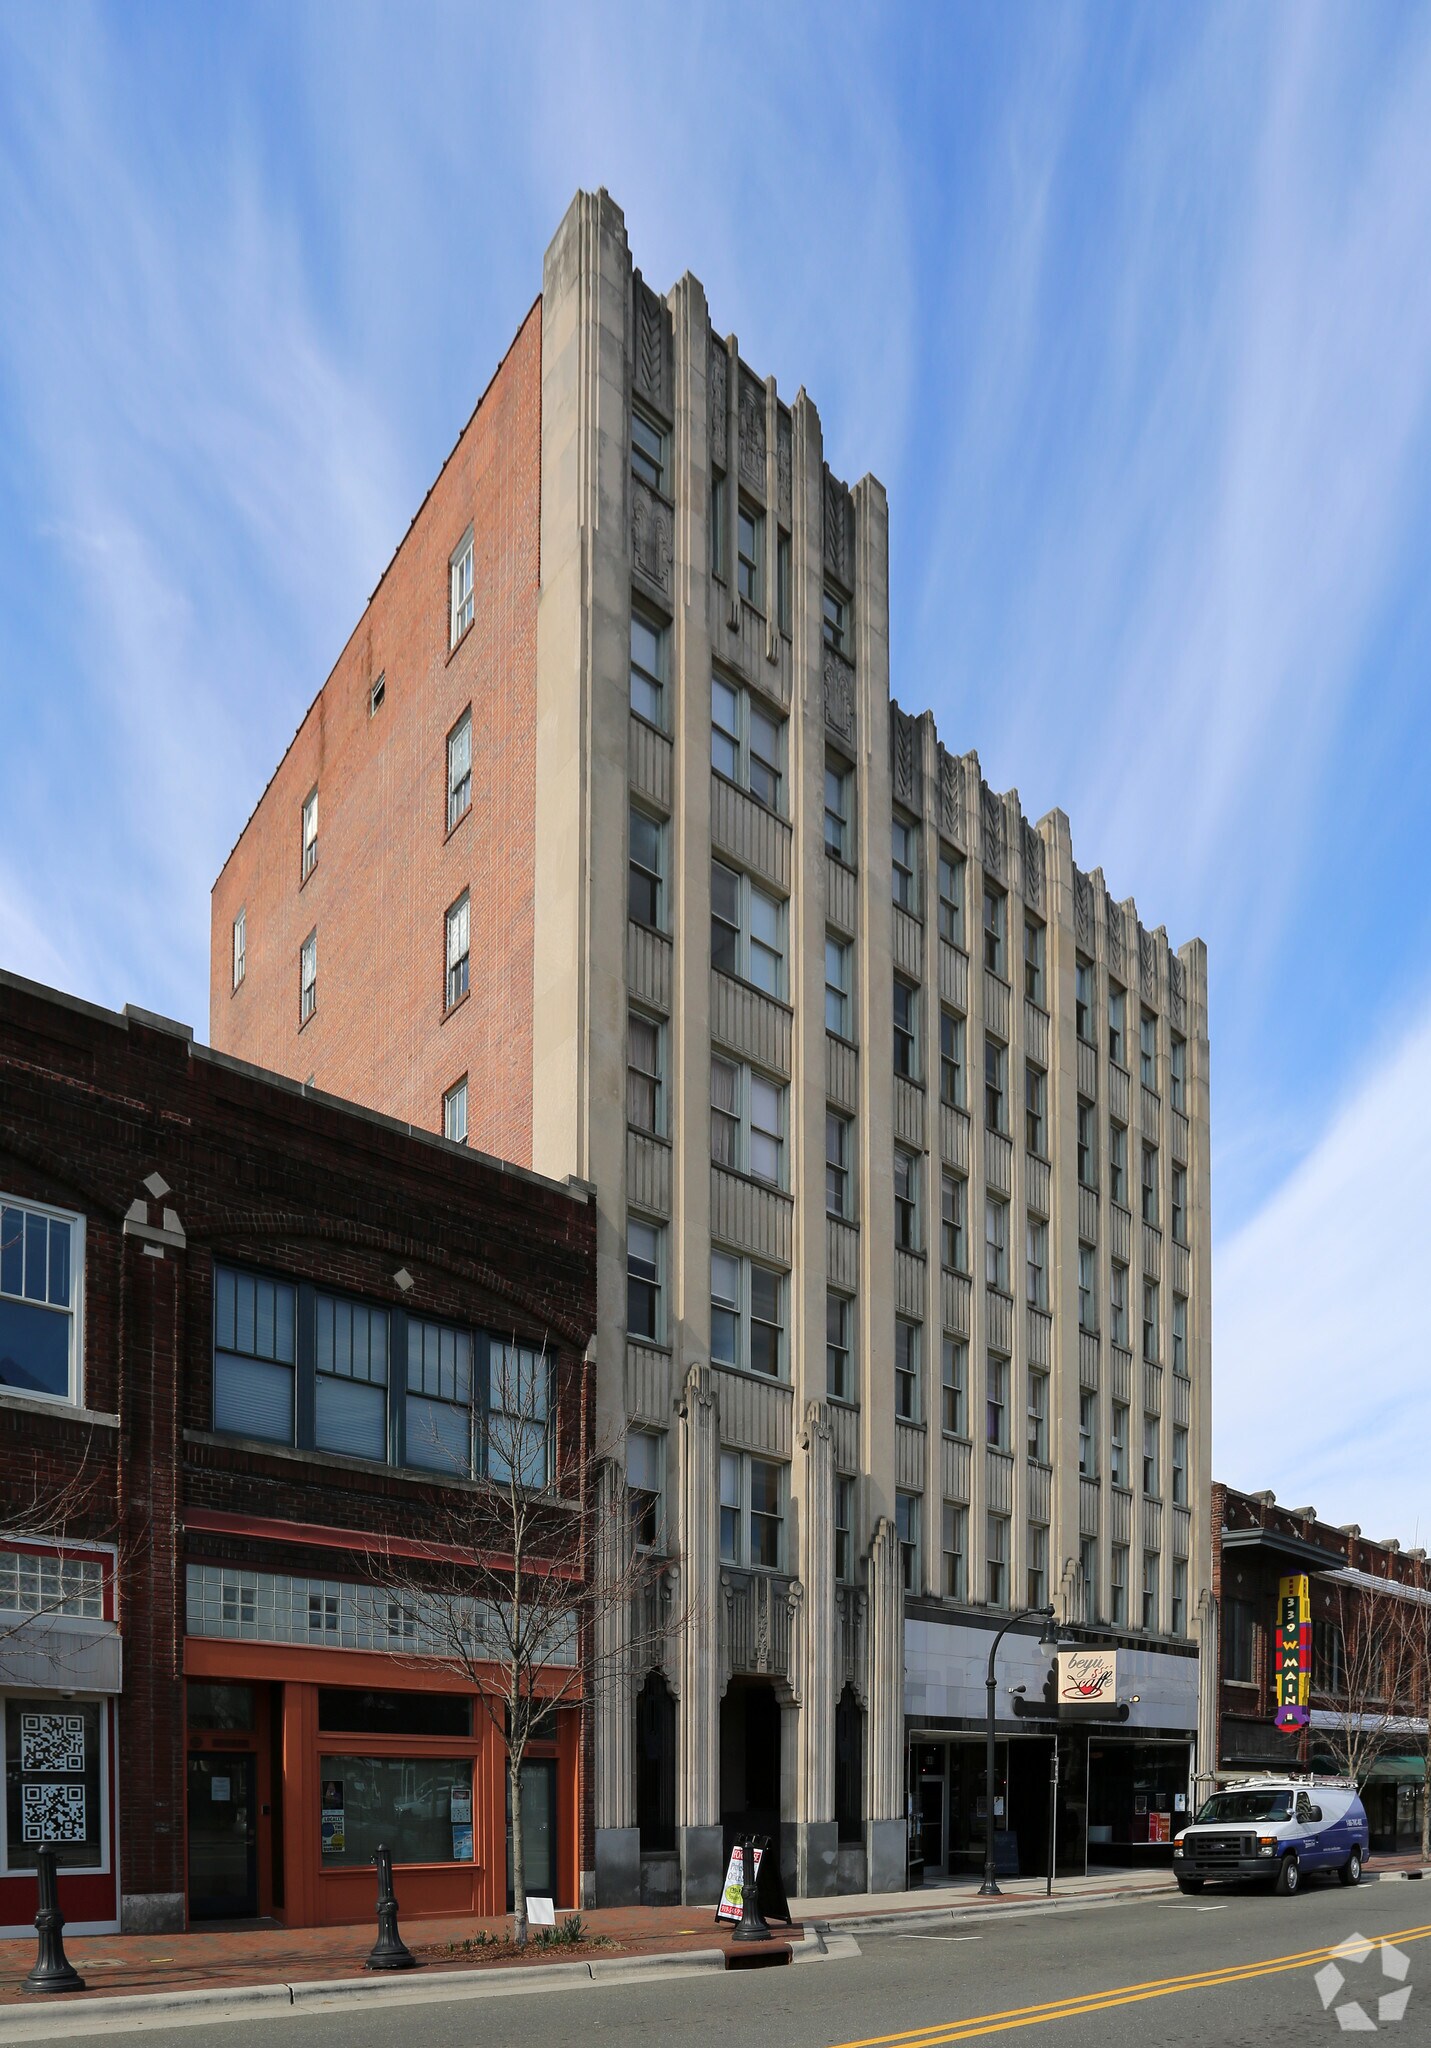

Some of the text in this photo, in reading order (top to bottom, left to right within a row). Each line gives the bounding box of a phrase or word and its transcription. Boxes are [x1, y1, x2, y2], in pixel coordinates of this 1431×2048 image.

[1283, 1598, 1299, 1704] 339 W. MAIN
